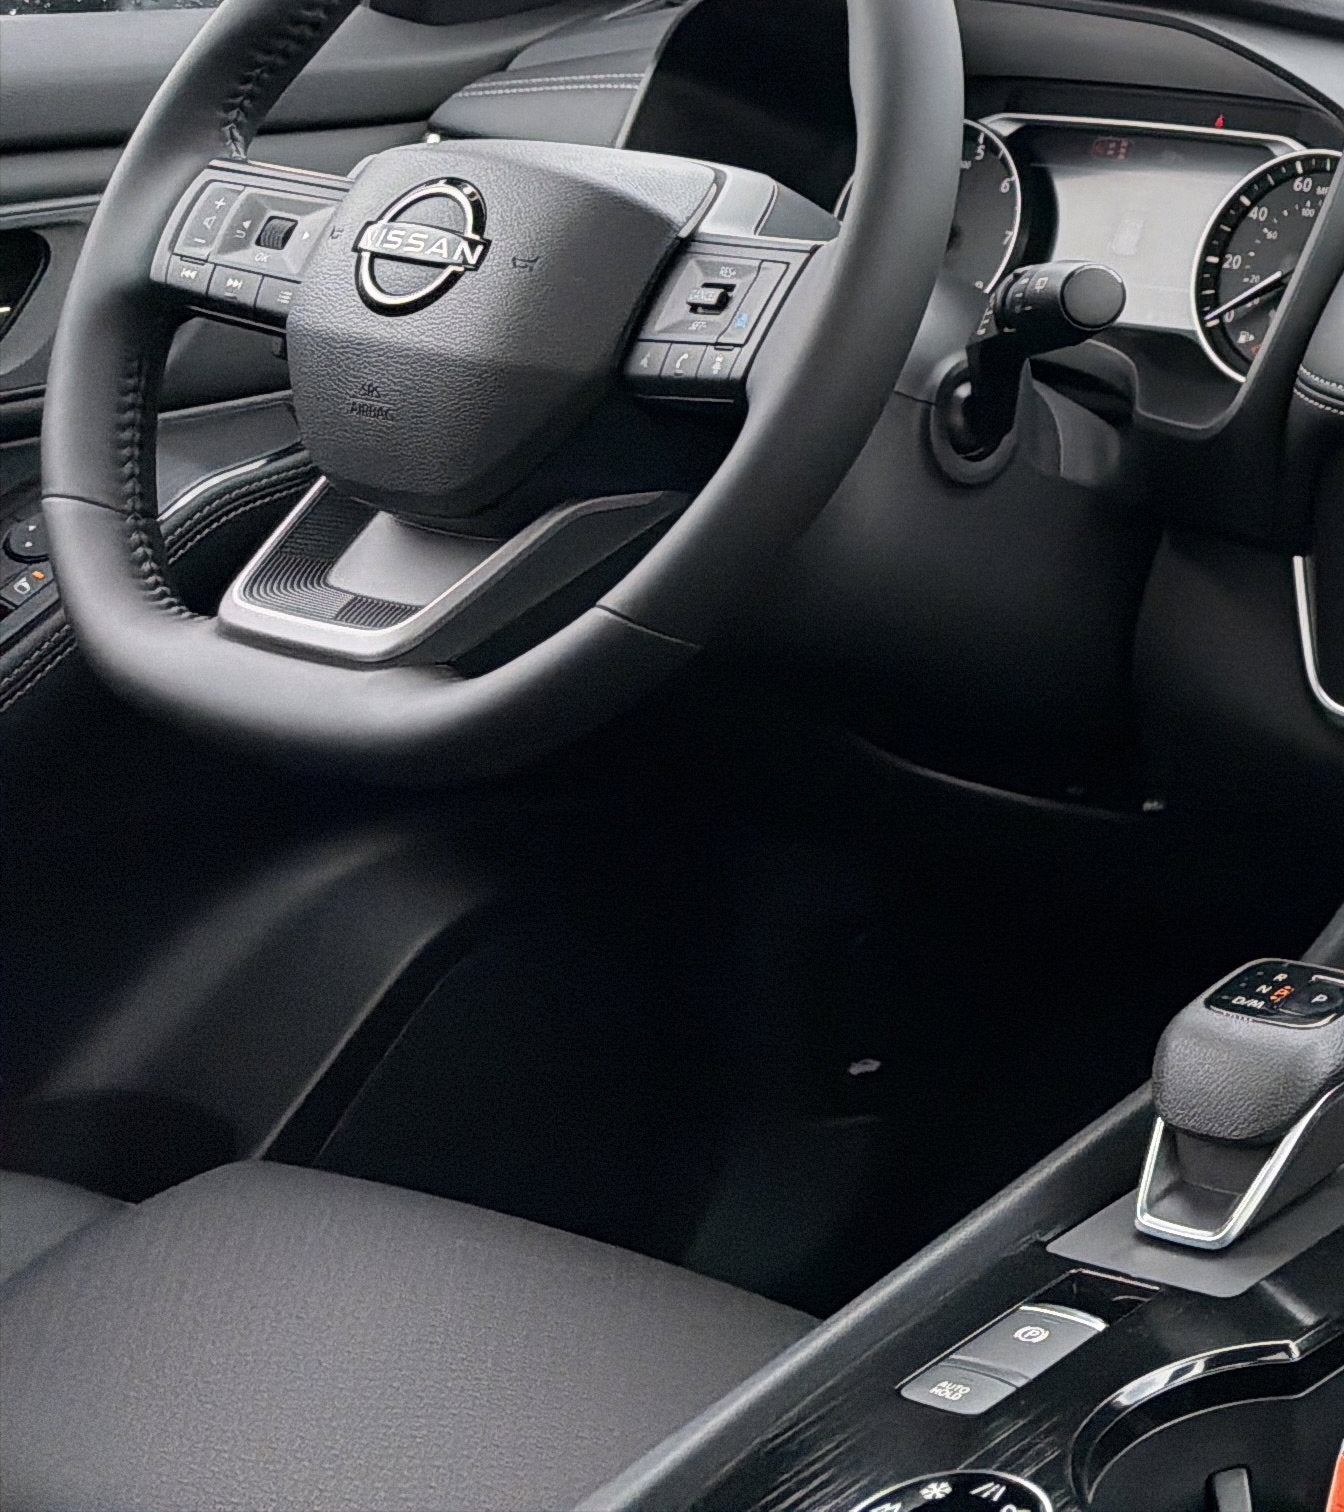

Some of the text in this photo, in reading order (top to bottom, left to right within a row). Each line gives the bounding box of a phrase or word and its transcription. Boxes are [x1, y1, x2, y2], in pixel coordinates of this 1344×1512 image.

[1292, 176, 1313, 193] 60
[1249, 206, 1268, 222] 40
[1222, 253, 1242, 269] 20
[929, 1386, 964, 1401] HOLD
[937, 1380, 971, 1395] AUTO
